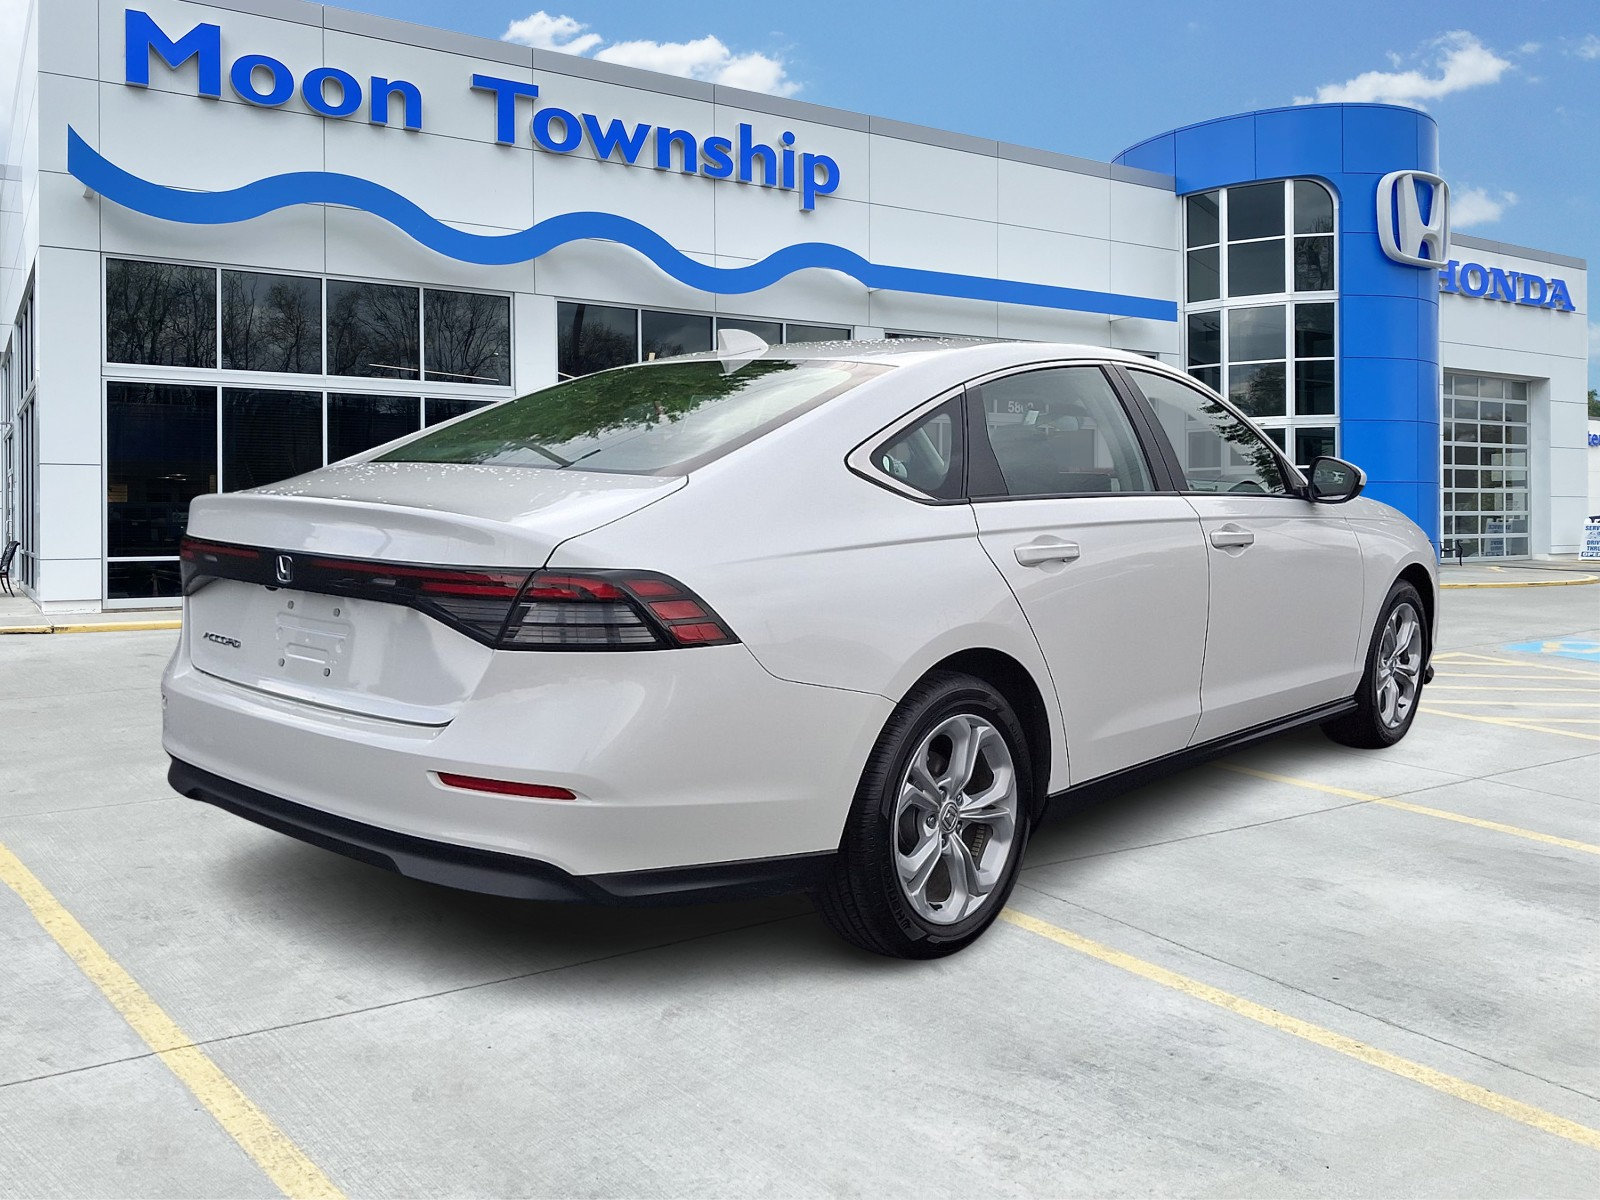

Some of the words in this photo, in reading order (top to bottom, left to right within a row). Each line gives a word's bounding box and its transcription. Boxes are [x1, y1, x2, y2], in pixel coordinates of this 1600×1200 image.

[124, 9, 422, 131] Moon
[470, 73, 841, 213] Township
[1438, 259, 1576, 312] HONDA
